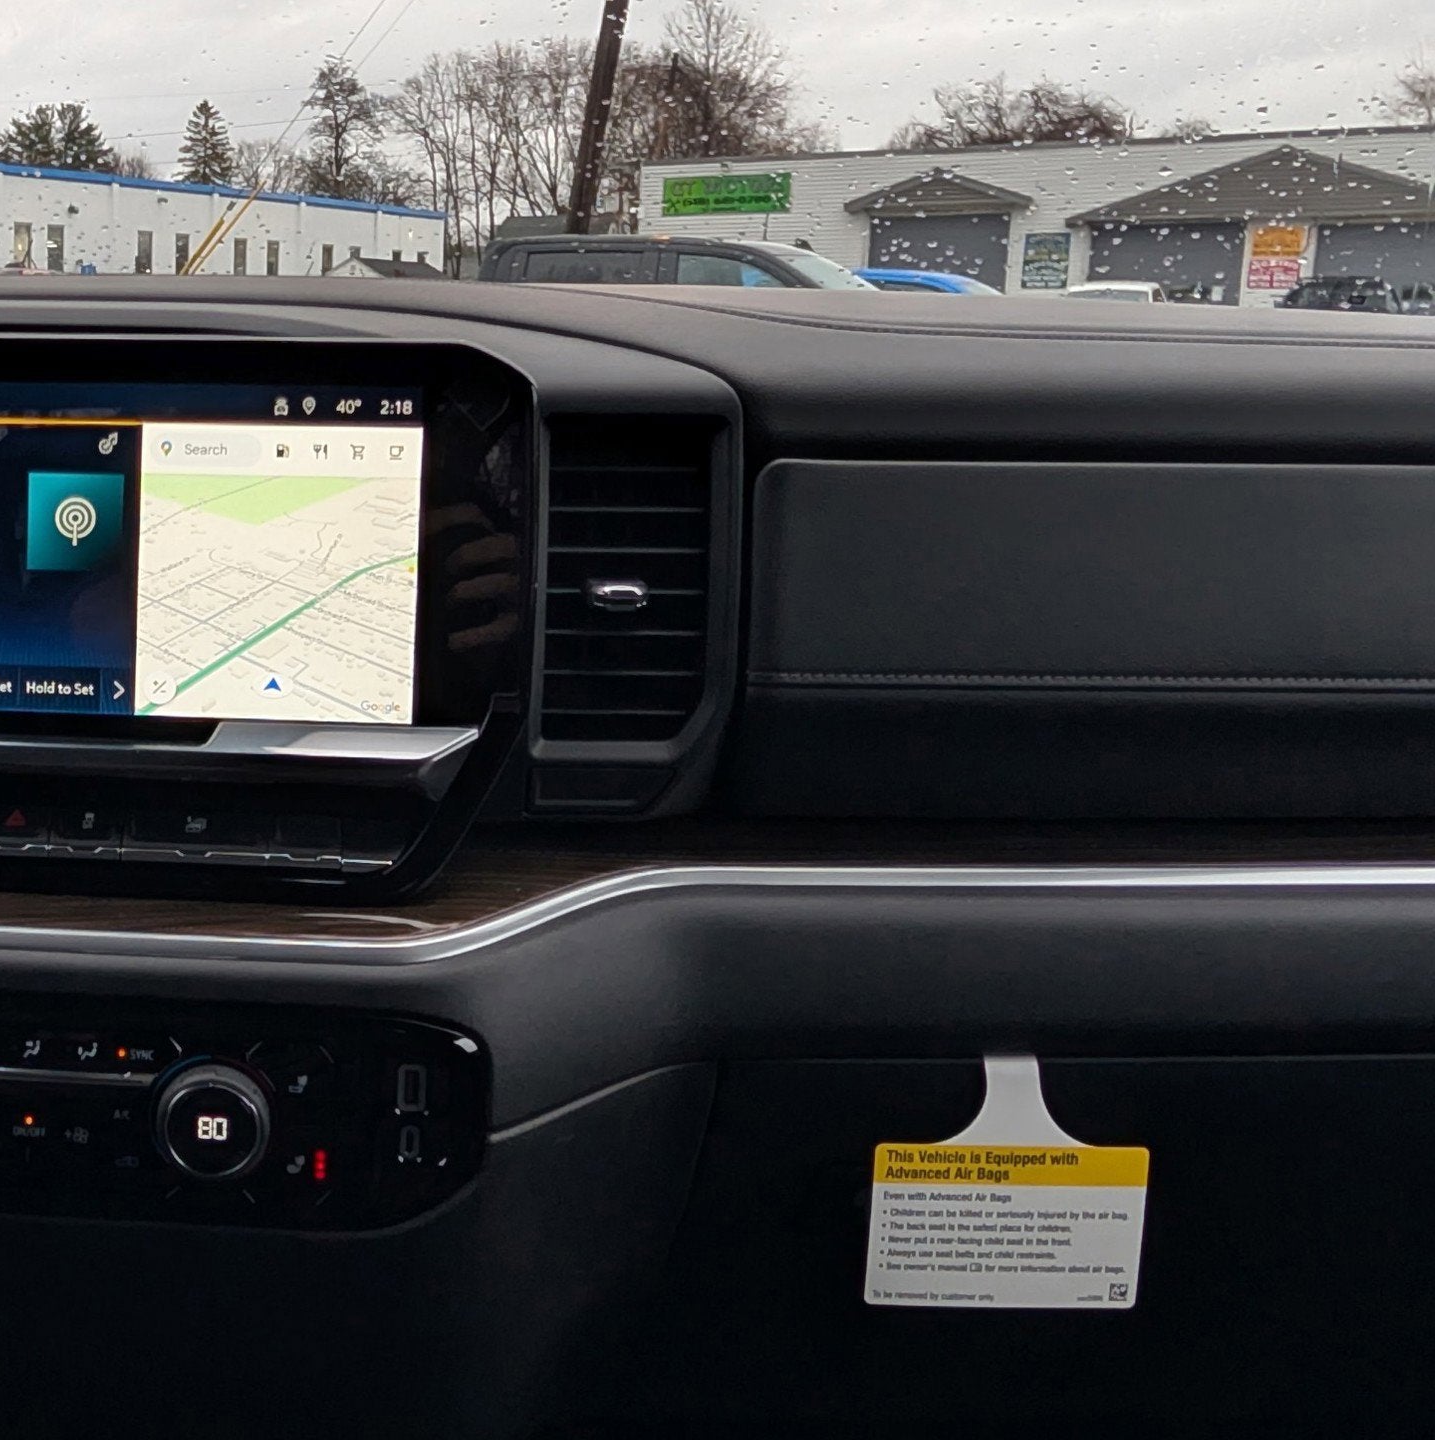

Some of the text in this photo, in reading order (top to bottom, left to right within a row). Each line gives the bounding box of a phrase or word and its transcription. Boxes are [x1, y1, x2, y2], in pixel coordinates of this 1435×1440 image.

[380, 399, 413, 416] 2:18
[183, 443, 228, 457] Search
[25, 681, 95, 696] Hold to Set
[360, 699, 401, 714] Google
[197, 1115, 228, 1141] 80
[887, 1149, 1079, 1168] This Vehicle is Equipped with
[884, 1166, 1010, 1183] Advanced Air Bags
[884, 1191, 1011, 1203] Even with Advanced Air Bags
[890, 1208, 926, 1217] Children
[946, 1209, 957, 1218] be
[960, 1210, 983, 1218] killed
[1070, 1211, 1080, 1221] by
[1082, 1211, 1096, 1219] the
